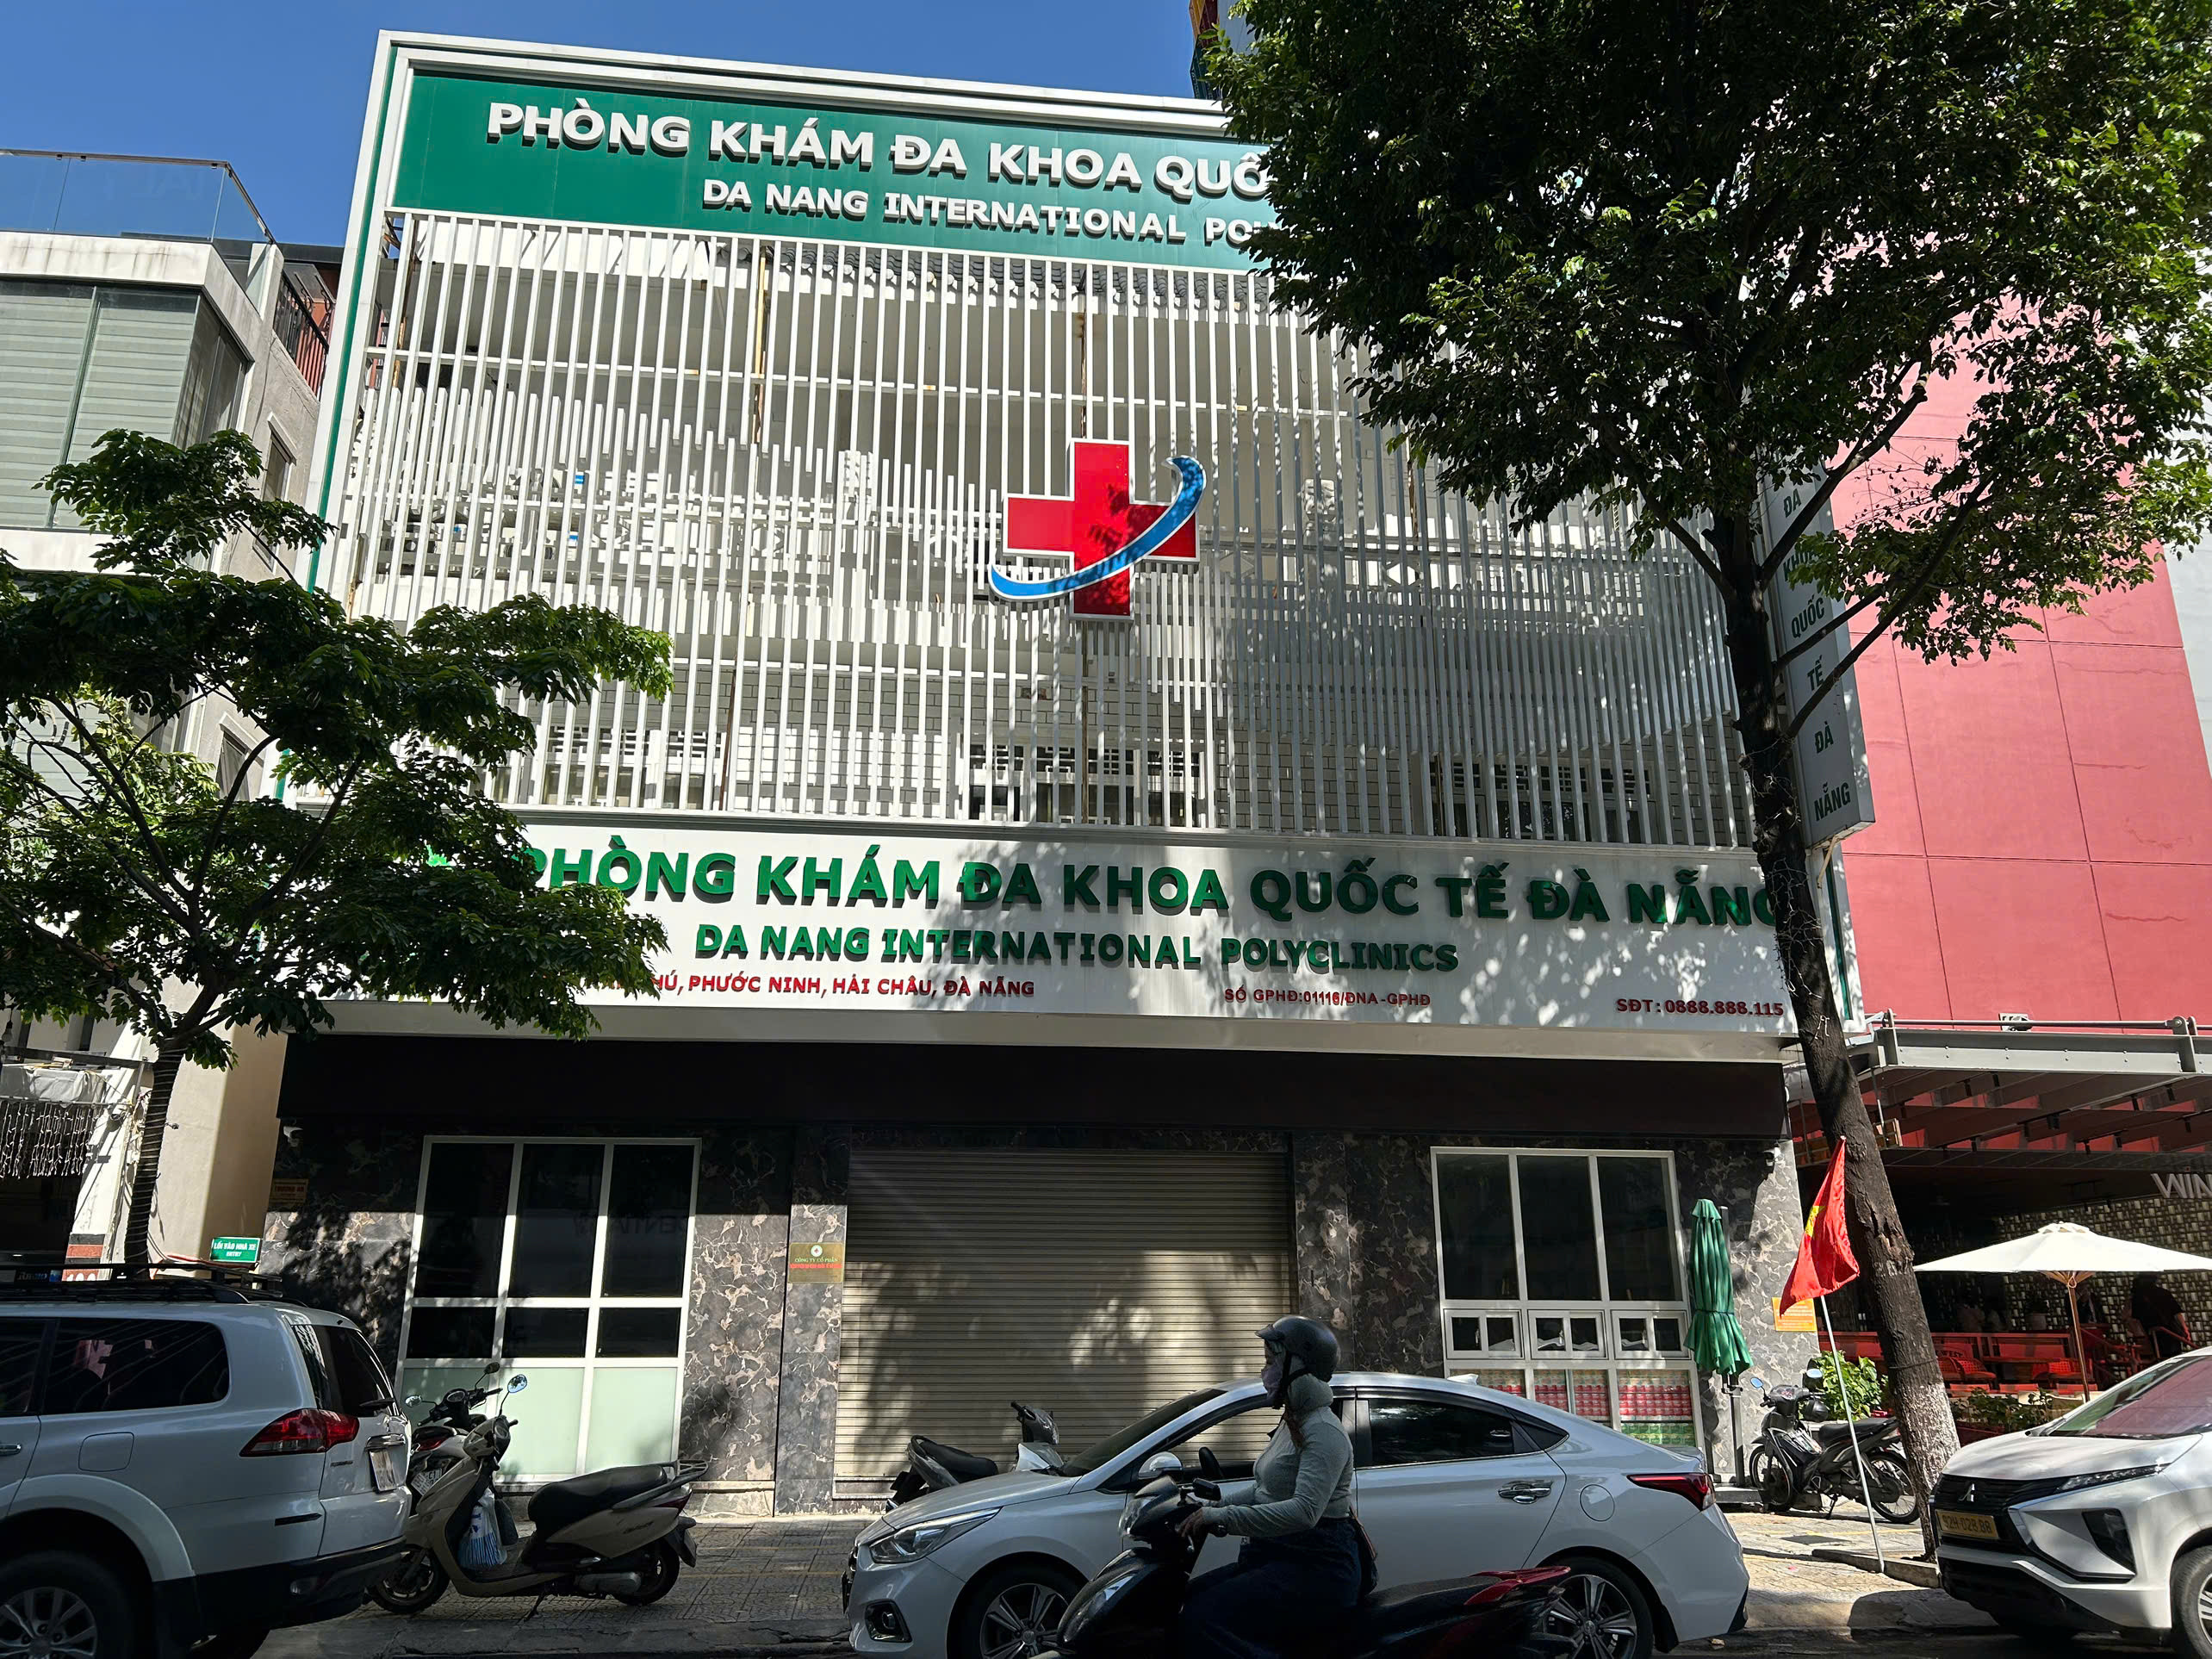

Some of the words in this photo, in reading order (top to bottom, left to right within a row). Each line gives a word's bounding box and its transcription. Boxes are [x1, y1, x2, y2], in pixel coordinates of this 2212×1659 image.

[487, 97, 690, 155] PHÒNG
[709, 117, 873, 170] KHÁM
[890, 134, 967, 175] ĐA
[990, 143, 1142, 191] KHOA
[1154, 152, 1273, 201] QUÔ
[703, 179, 752, 209] DA
[766, 183, 868, 218] NANG
[884, 193, 1186, 242] INTERNATIONAL
[1791, 594, 1825, 639] QUỐC
[1807, 655, 1824, 690] TẾ
[1815, 721, 1834, 754] ĐÀ
[1814, 782, 1851, 821] NẴNG
[756, 844, 940, 907] KHÁM
[957, 862, 1041, 908] ĐA
[1063, 864, 1229, 914] KHOA
[1250, 858, 1419, 921] QUỐC
[1435, 862, 1509, 919] TẾ
[1525, 868, 1610, 922] ĐÀ
[695, 924, 748, 957] DA
[760, 925, 869, 960] NANG
[880, 928, 1201, 968] INTERNATIONAL
[1221, 937, 1459, 972] POLYCLINICS
[688, 971, 761, 992] PHƯỚC
[768, 976, 827, 998] NINH,
[832, 973, 870, 994] HẢI
[877, 975, 937, 999] CHÂU,
[943, 976, 972, 997] ĐÀ
[979, 976, 1035, 997] NẴNG
